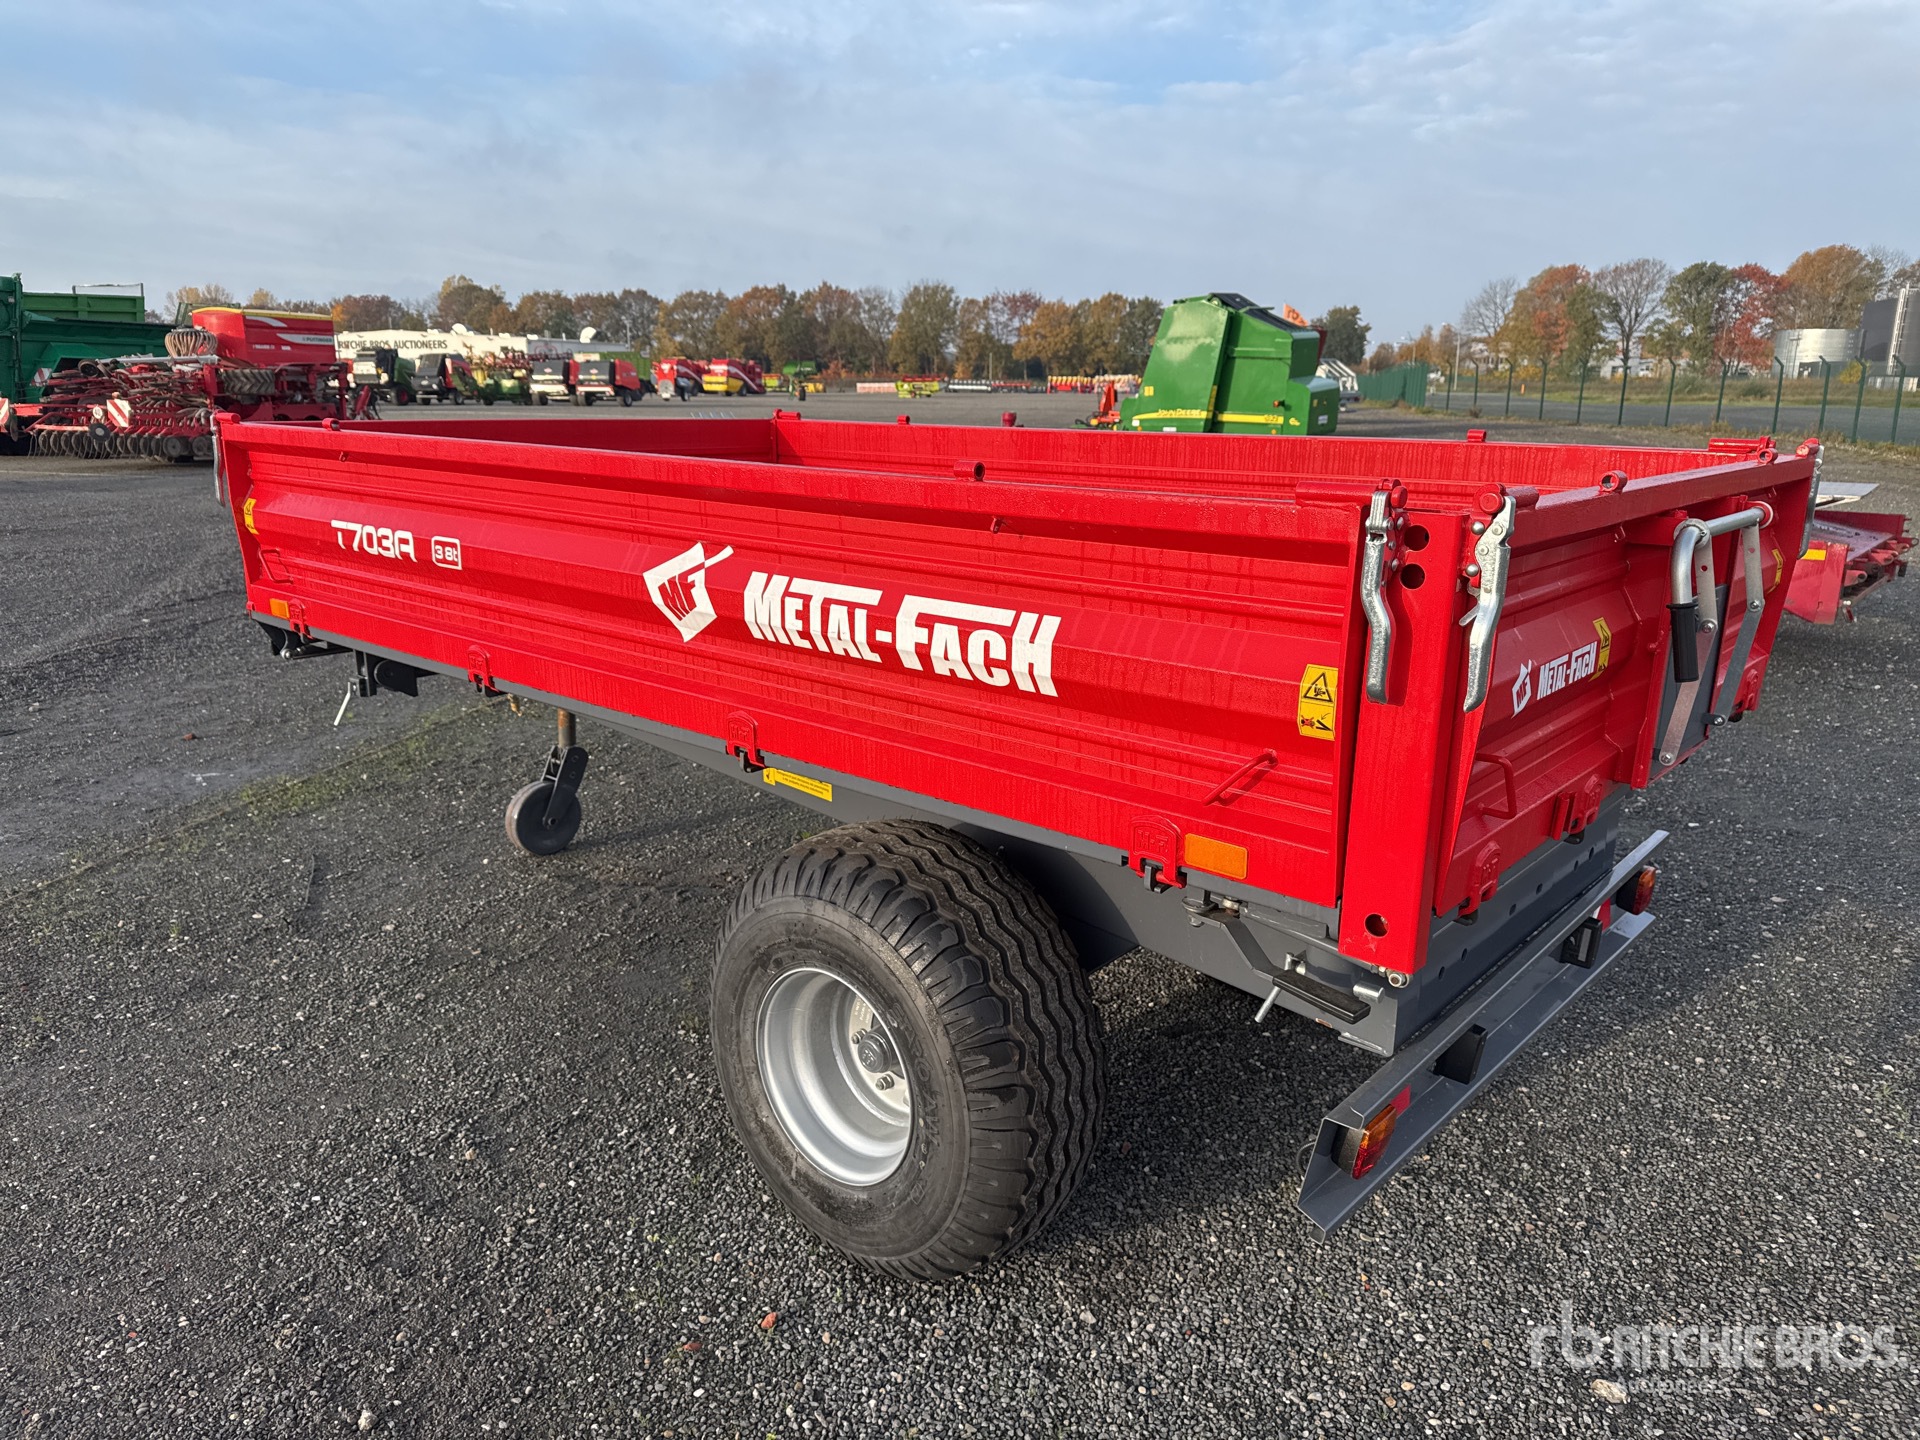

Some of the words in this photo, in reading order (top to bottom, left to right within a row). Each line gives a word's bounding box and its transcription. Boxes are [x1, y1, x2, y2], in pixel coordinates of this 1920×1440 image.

[338, 340, 367, 349] RITCHIE
[393, 340, 448, 350] AUCTIONEERS
[743, 571, 1062, 698] METAL-FACH
[1537, 641, 1598, 700] METAL-FACH
